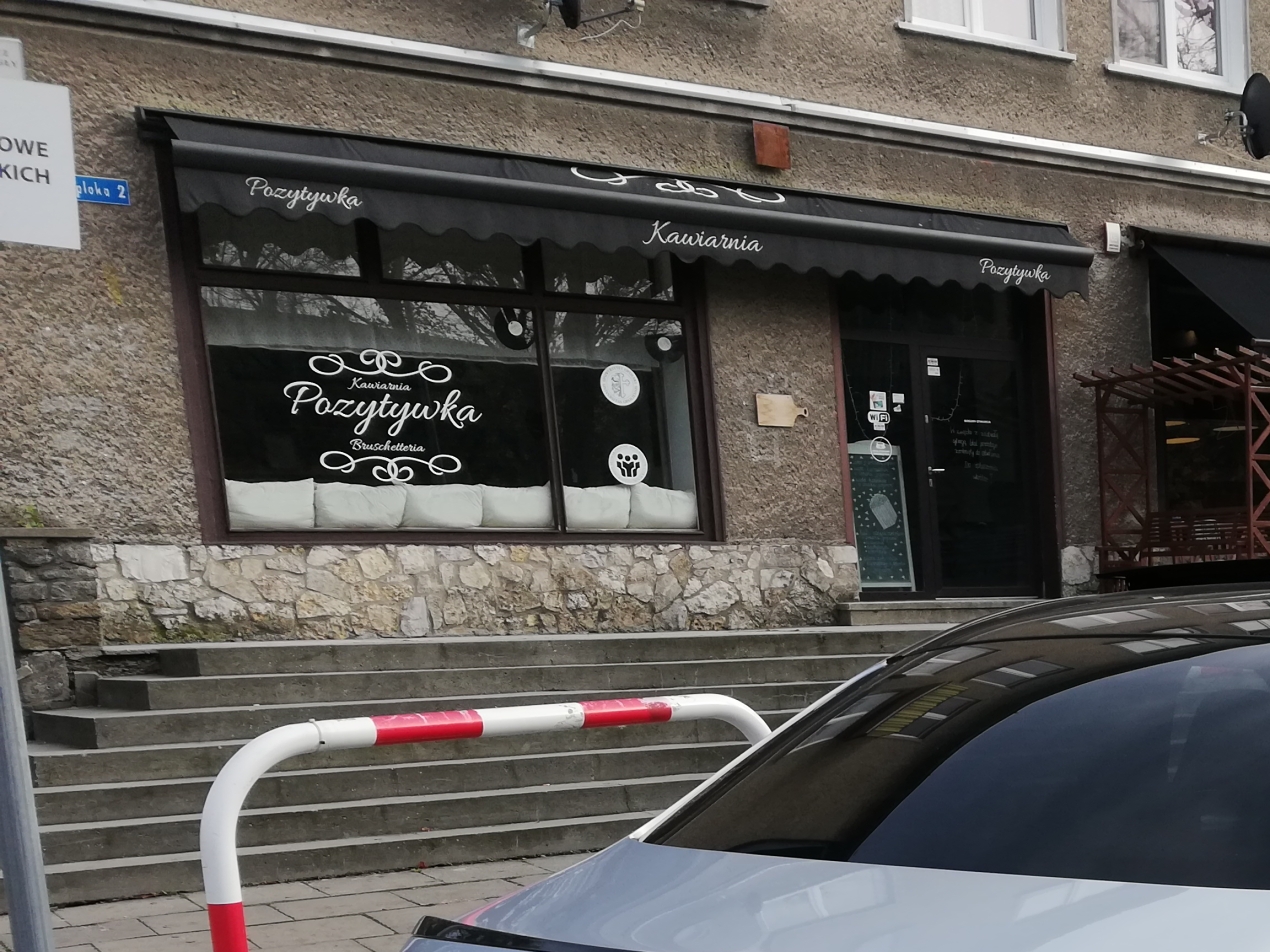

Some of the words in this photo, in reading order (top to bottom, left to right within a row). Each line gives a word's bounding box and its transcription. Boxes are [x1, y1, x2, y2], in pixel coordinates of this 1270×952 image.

[117, 185, 126, 198] 2
[245, 177, 362, 211] Pozytywka
[642, 221, 763, 253] Kawiarnia
[979, 258, 1051, 285] Pozytywka
[347, 377, 412, 392] Kawiarnia
[283, 381, 483, 437] Pozytywka
[349, 438, 426, 453] Bruschetteria
